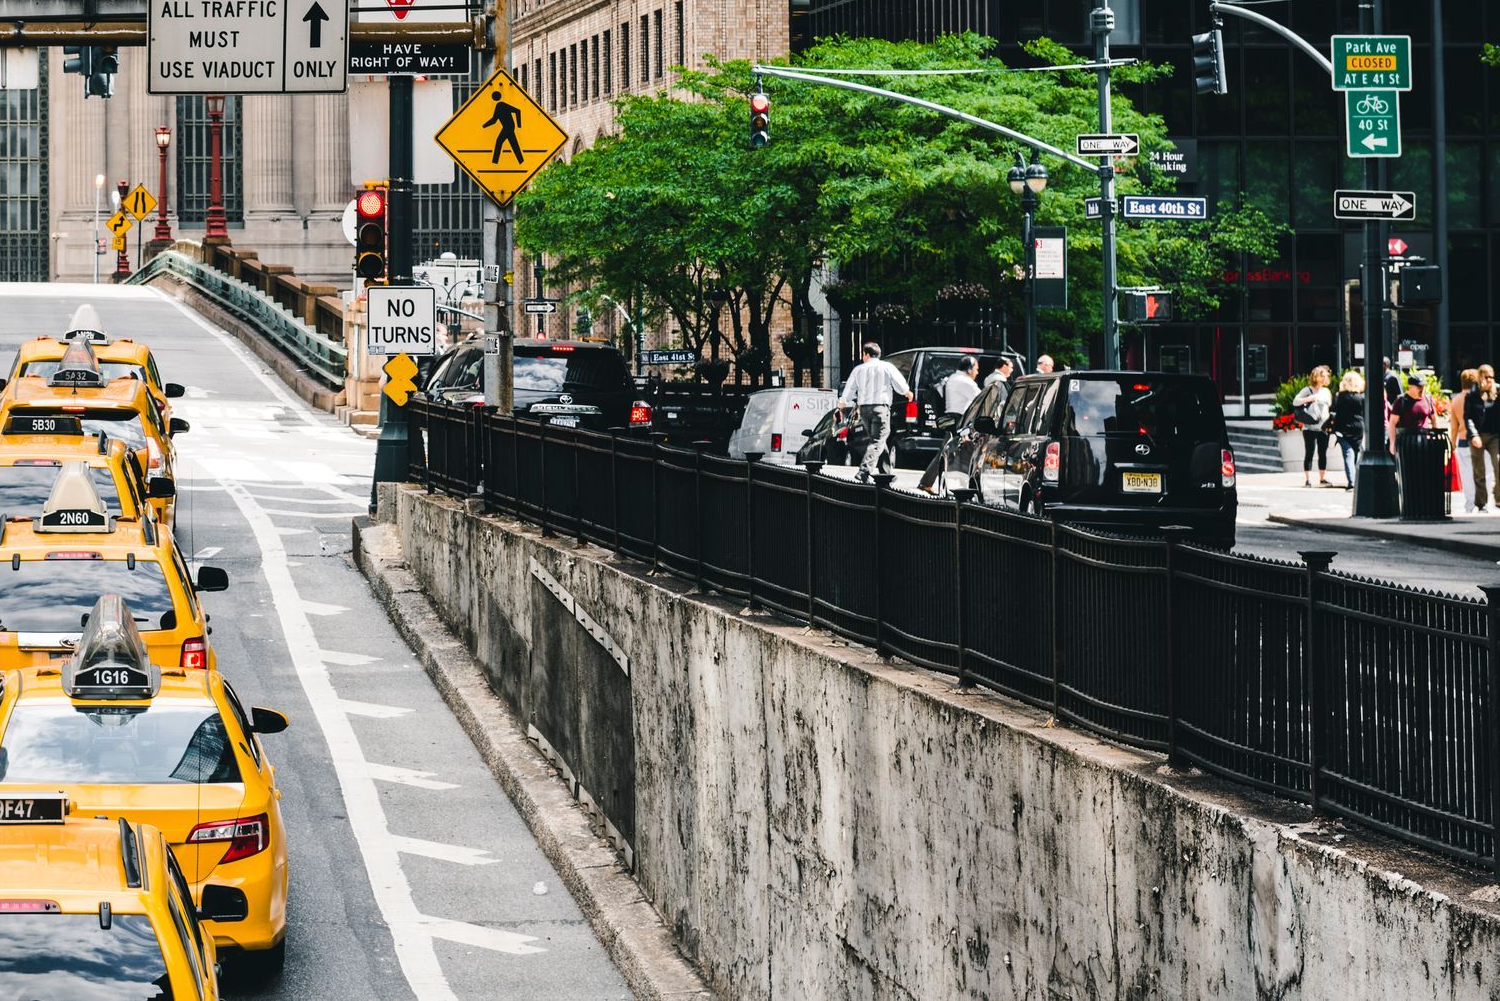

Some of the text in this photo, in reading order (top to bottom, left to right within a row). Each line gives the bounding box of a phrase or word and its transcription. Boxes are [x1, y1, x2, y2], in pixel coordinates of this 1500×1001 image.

[161, 0, 277, 18] ALL TRAFFIC
[189, 31, 240, 48] MUST
[383, 44, 422, 54] HAVE
[1345, 42, 1397, 53] Park Ave
[351, 56, 454, 68] RIGHT OF WAY!
[1351, 57, 1392, 68] CLOSED
[160, 61, 276, 78] USE VIADUCT
[293, 60, 337, 78] ONLY
[1344, 73, 1400, 85] AT E 41 St
[1358, 120, 1388, 130] 40 St
[1082, 141, 1131, 149] ONE WAY
[1149, 151, 1184, 161] 24 Hour
[1129, 201, 1201, 215] East 40th St
[1342, 199, 1405, 211] ONE WAY
[388, 299, 415, 317] NO
[371, 326, 431, 344] TURNS
[653, 353, 669, 362] East
[32, 419, 56, 431] 5B30
[59, 512, 89, 524] 2N60
[93, 670, 129, 684] 1G16
